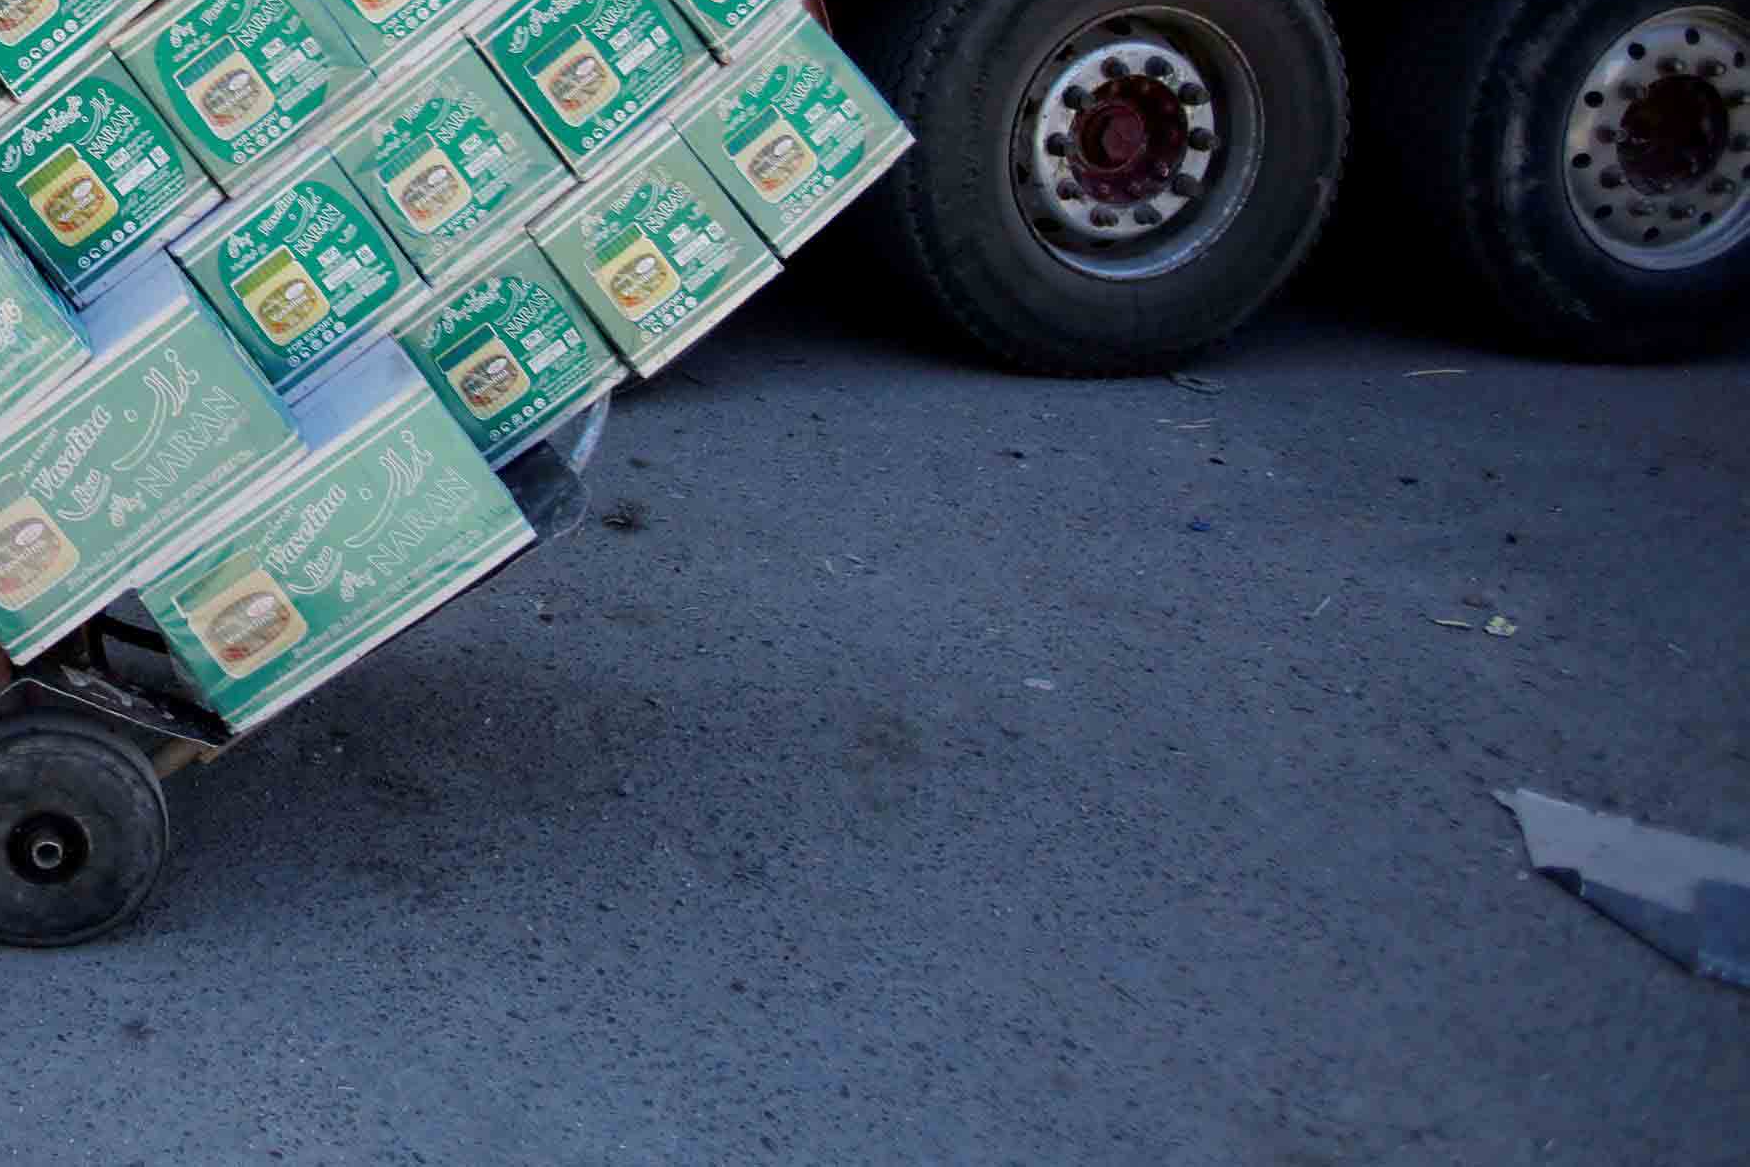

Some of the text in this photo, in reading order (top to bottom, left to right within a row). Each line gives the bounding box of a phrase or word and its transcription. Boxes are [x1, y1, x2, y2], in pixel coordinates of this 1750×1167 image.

[86, 104, 134, 159] NARAN
[293, 201, 341, 256] NARAN
[644, 180, 691, 233] NARAN
[502, 287, 550, 339] NARAN
[31, 405, 112, 500] Vaselina
[136, 385, 236, 498] NARAN
[265, 484, 347, 575] Vaselina
[367, 466, 469, 574] NARAN
